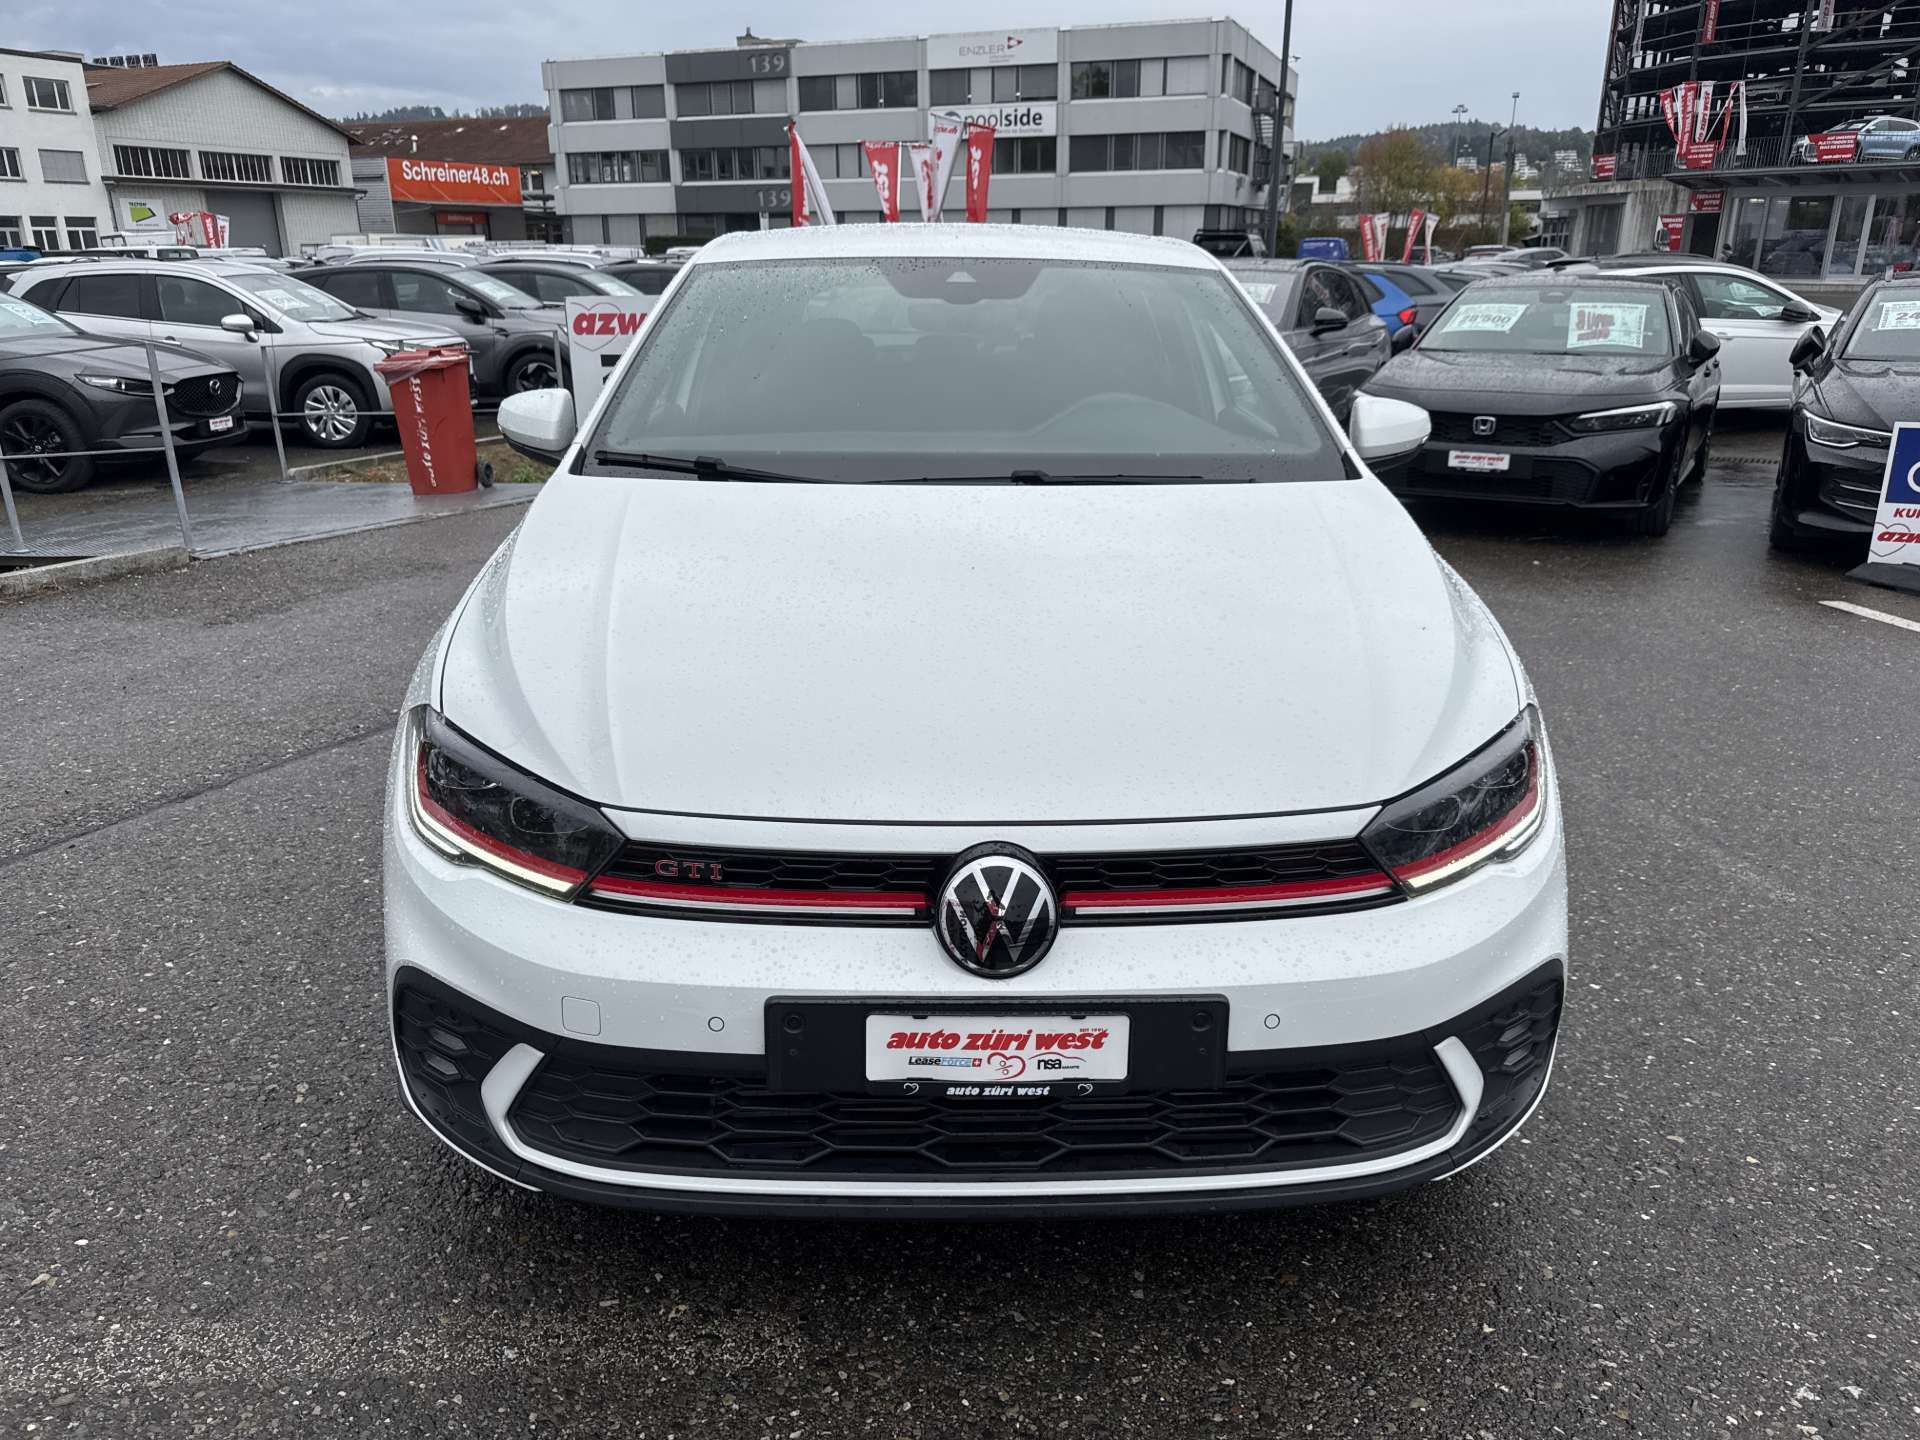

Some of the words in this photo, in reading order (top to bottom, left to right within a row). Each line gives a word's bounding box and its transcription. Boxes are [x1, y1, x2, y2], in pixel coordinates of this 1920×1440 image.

[959, 44, 1005, 57] ENZLER
[750, 54, 785, 73] 139
[402, 160, 510, 186] Schreiner48.ch
[758, 190, 791, 207] 139
[573, 312, 648, 336] azw
[655, 859, 722, 880] GTI
[886, 1029, 961, 1050] auto
[961, 1028, 1034, 1051] züri
[1035, 1030, 1109, 1050] west
[1037, 1059, 1062, 1070] nsa
[946, 1085, 980, 1096] auto
[981, 1084, 1014, 1096] züri
[1017, 1085, 1051, 1096] west
